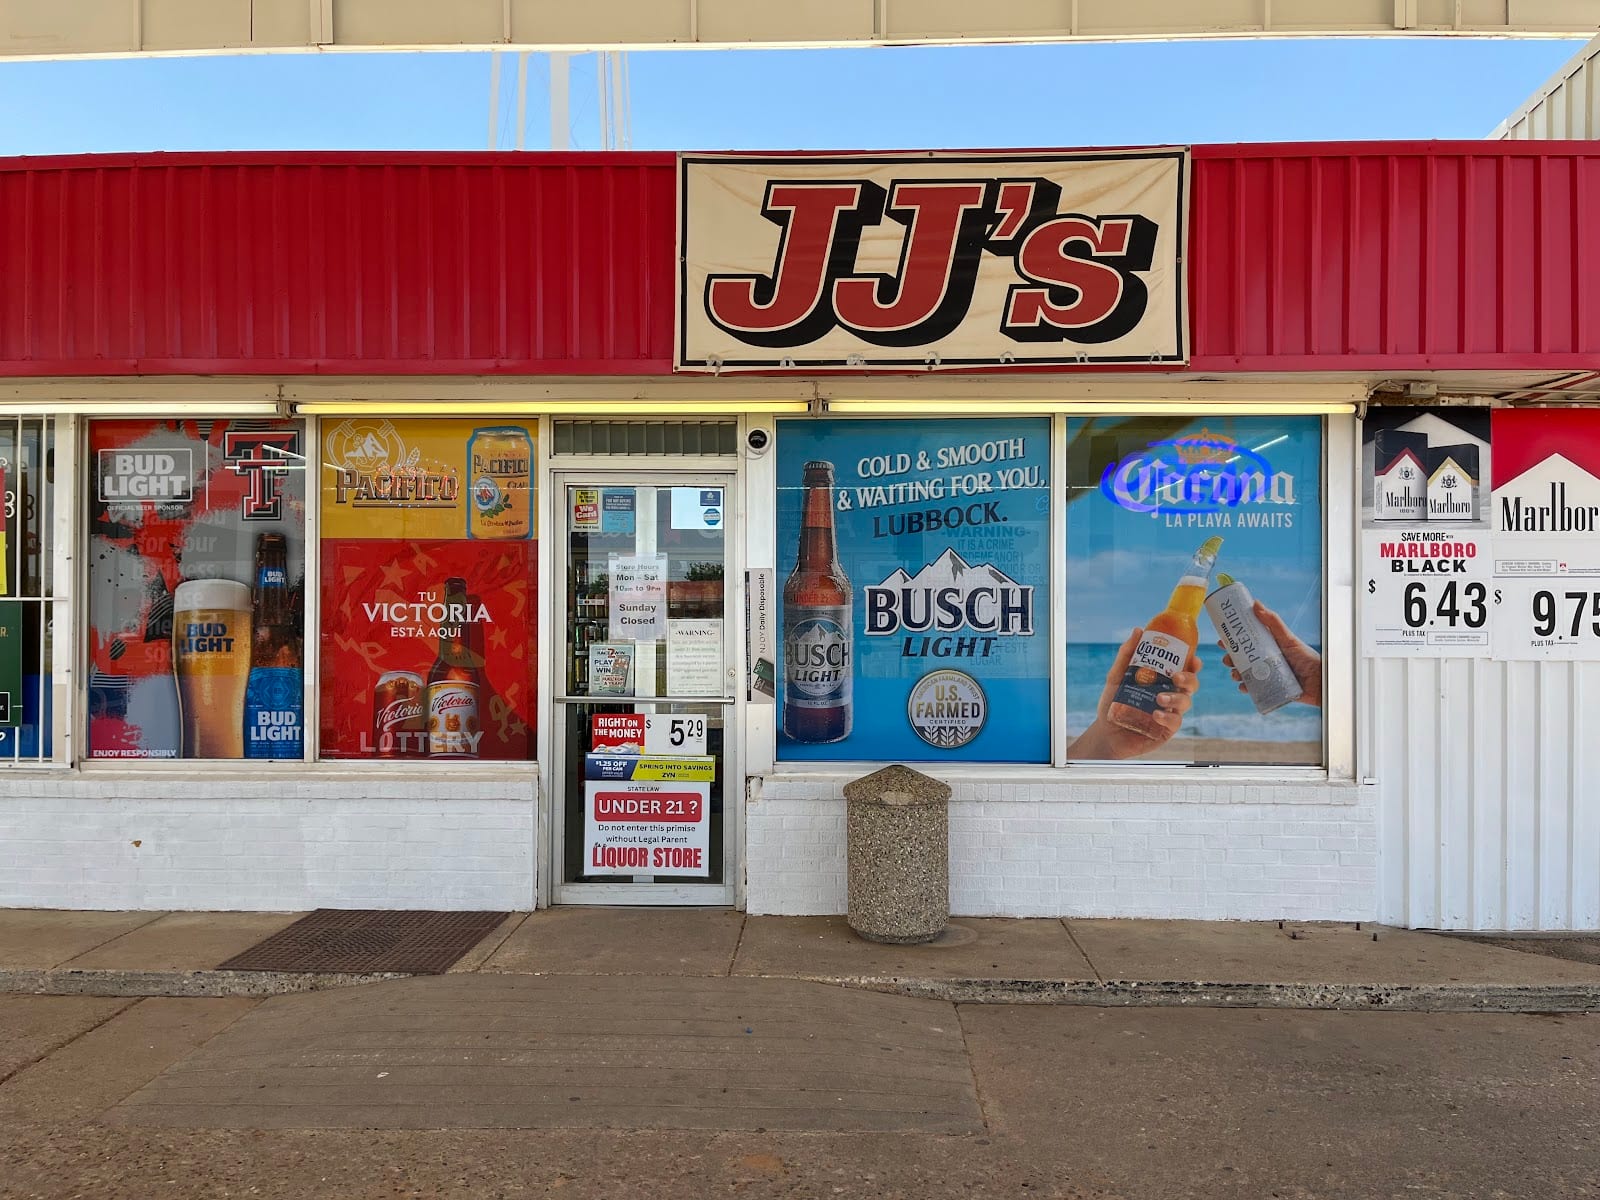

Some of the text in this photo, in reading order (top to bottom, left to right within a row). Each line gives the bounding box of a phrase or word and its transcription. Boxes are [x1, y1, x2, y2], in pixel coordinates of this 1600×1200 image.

[704, 177, 1158, 348] JJ's
[115, 454, 175, 475] BUD
[857, 437, 1025, 479] COLD & SMOOTH
[104, 476, 187, 496] LIGHT
[837, 465, 1047, 512] & WAITING FOR YOU,
[1114, 458, 1296, 519] Corona
[1429, 492, 1471, 513] Marlboro
[873, 500, 1008, 538] LUBBOCK.
[1165, 512, 1293, 528] LA PLAYA AWAITS
[1401, 532, 1421, 542] SAVE
[1422, 532, 1446, 542] MORE
[1380, 542, 1477, 558] MARLBORO
[1391, 559, 1467, 573] BLACK
[417, 591, 436, 601] TU
[758, 573, 766, 611] Disposable
[1494, 589, 1502, 605] $
[619, 603, 656, 613] Sunday
[865, 585, 1034, 635] BUSCH
[1368, 578, 1487, 628] $ 6.43
[362, 602, 493, 622] VICTORIA
[620, 616, 655, 625] Closed
[758, 613, 766, 631] Daily
[186, 623, 227, 637] BUD
[391, 625, 462, 639] ESTÁ AQUÍ
[1220, 598, 1260, 664] PREMIER
[1221, 623, 1239, 653] Corona
[181, 638, 235, 653] LIGHT
[902, 636, 997, 657] LIGHT
[1137, 641, 1180, 665] Corona
[785, 642, 850, 667] BUSCH
[1140, 654, 1164, 669] Extra
[794, 669, 841, 682] LIGHT
[935, 685, 962, 701] U.S.
[431, 692, 475, 714] Victoria
[916, 702, 980, 718] FARMED
[257, 711, 297, 726] BUD
[598, 718, 638, 728] RIGHT ON
[645, 719, 652, 730] $
[250, 726, 301, 741] LIGHT
[594, 728, 642, 738] THE MONEY
[359, 731, 484, 753] LOTTERY
[93, 749, 177, 757] ENJOY RESPONSIBLY
[598, 800, 698, 814] UNDER 21 ?
[598, 824, 610, 832] Do
[626, 824, 648, 832] enter
[649, 824, 665, 832] this
[666, 825, 696, 833] primise
[606, 835, 688, 844] without Legal Parent
[592, 847, 702, 868] LIQUOR STORE
